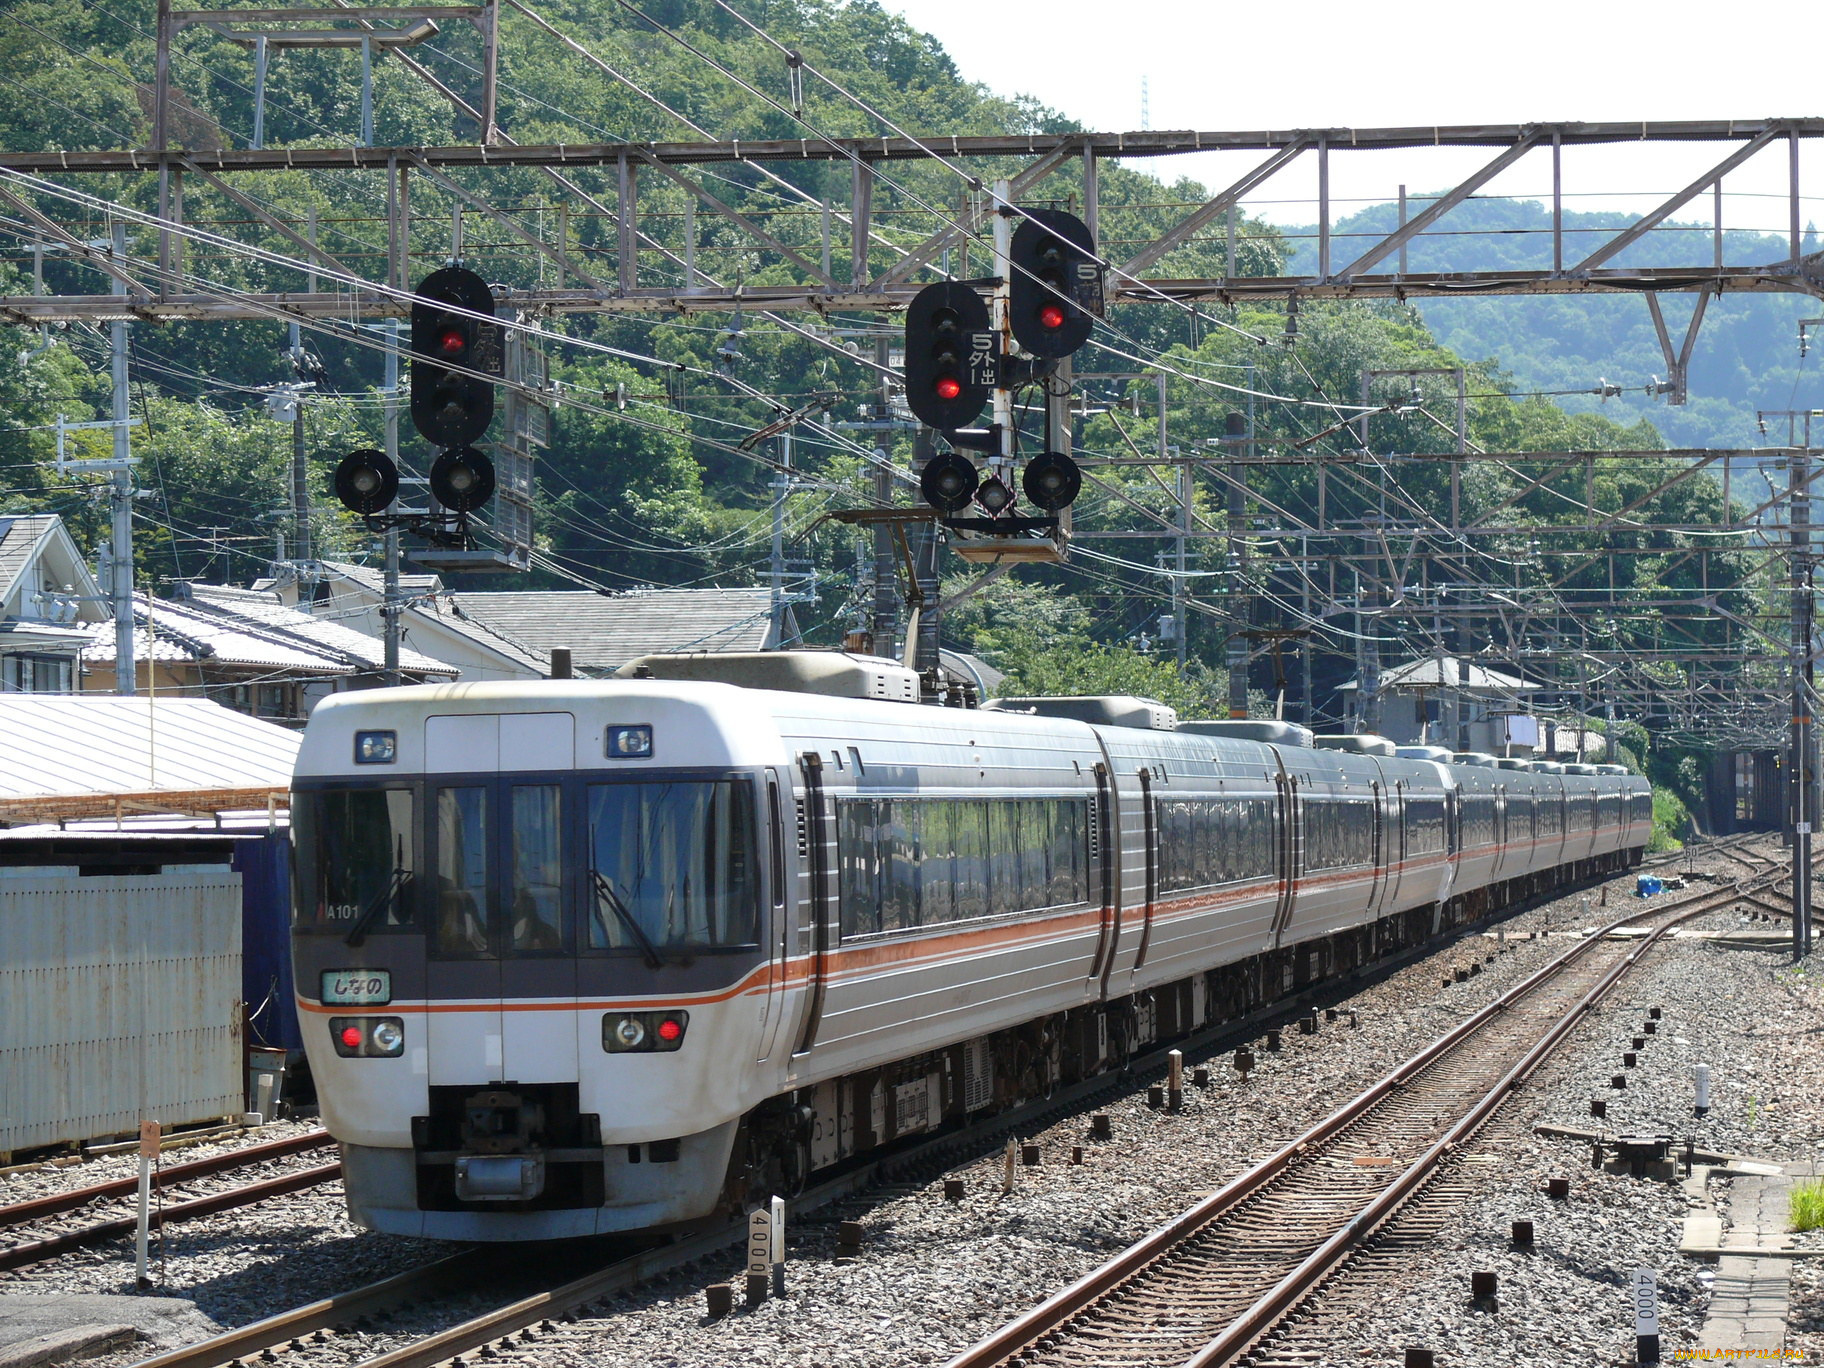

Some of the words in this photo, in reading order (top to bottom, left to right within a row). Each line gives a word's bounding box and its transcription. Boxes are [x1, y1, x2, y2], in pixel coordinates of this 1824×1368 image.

[1077, 263, 1097, 280] 5
[972, 334, 993, 350] 5
[1685, 847, 1697, 858] 60
[327, 905, 359, 920] A101
[334, 977, 383, 996] しなの
[750, 1216, 769, 1272] 4000
[1637, 1274, 1654, 1320] 4000
